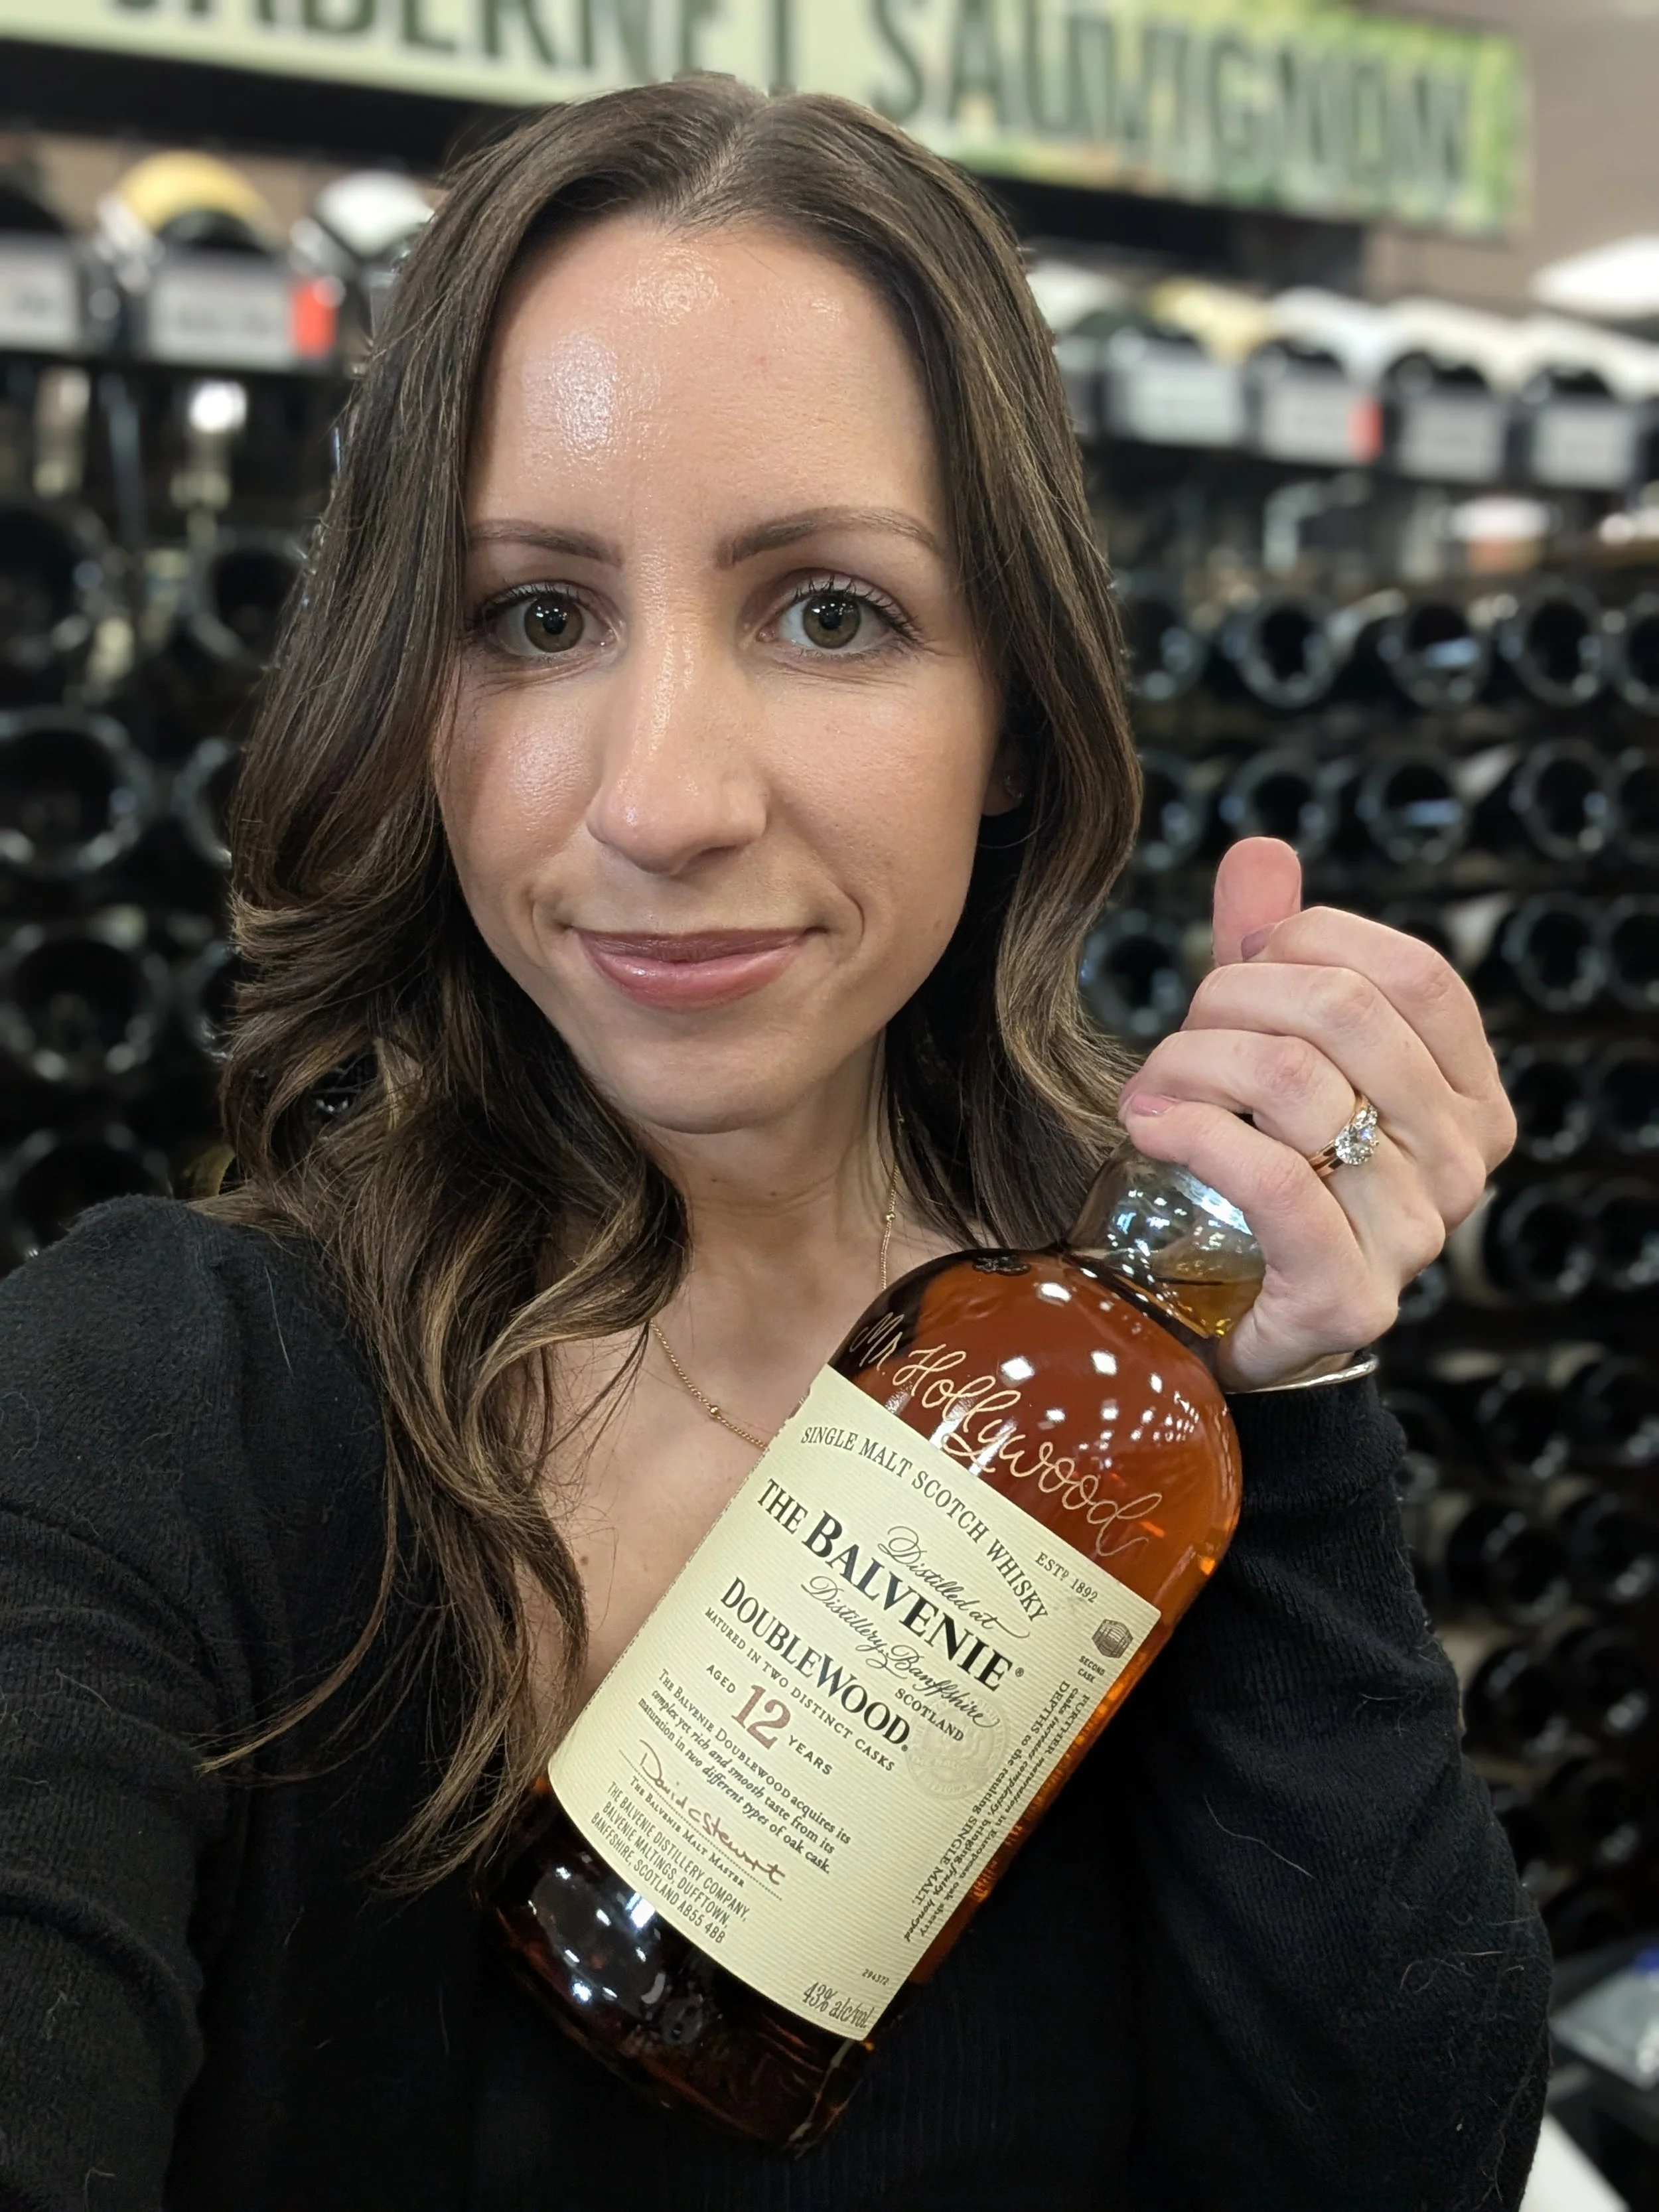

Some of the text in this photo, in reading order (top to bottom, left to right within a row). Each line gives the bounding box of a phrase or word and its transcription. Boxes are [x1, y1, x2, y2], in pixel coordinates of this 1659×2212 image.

[847, 1310, 1164, 1559] Mr. Hollywood
[757, 1477, 808, 1534] THE
[800, 1426, 1048, 1622] SINGLE MALT SCOTCH WHISKY
[877, 1525, 1030, 1639] Distilled at
[1069, 1578, 1098, 1603] 1892
[704, 1607, 895, 1771] MATURED IN TWO DISTINCT CASKS
[886, 1644, 1000, 1728] Banffshire
[1057, 1687, 1078, 1715] casks
[1076, 1667, 1096, 1683] CASK
[1078, 1655, 1106, 1676] SECOND
[705, 1664, 833, 1775] AGED 12 YEARS
[894, 1687, 964, 1741] SCOTLAND
[1027, 1716, 1059, 1761] increases
[637, 1697, 830, 1874] maturation in two different types of oak cask.
[650, 1689, 835, 1854] complex yet rich and smooth taste from its
[911, 1680, 1070, 1905] DEPTHS to the resulting SINGLE MALT.
[986, 1760, 1029, 1816] complexity,
[607, 1780, 750, 1922] THE BALVENIE DISTILLERY COMPANY,
[789, 1795, 835, 1833] acquires
[835, 1827, 851, 1844] its
[919, 1694, 1090, 1937] FURTHER maturation in European oak sherry
[952, 1818, 991, 1864] bringing
[590, 1811, 725, 1943] BANFFSHIRE, SCOTLAND AB55 4BB
[602, 1801, 730, 1929] BALVENIE MALTINGS, DUFFTOWN,
[903, 1897, 936, 1943] honeyed
[802, 1981, 875, 2029] 43% alc/vol.
